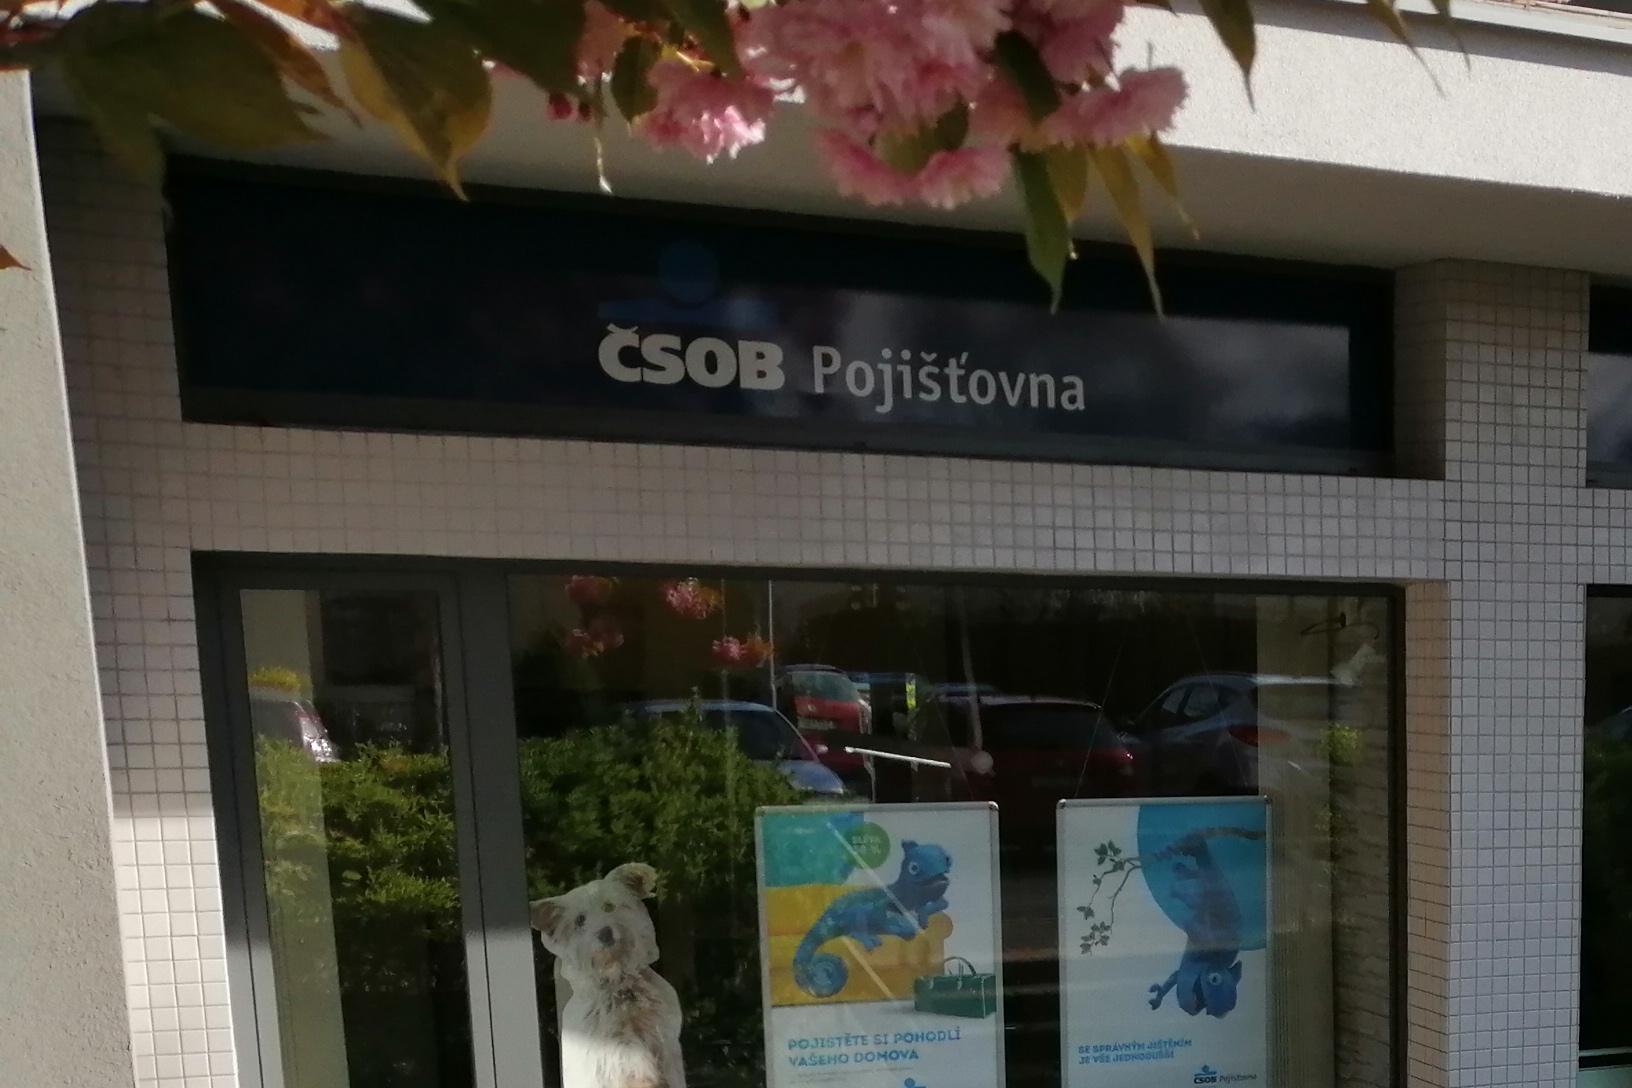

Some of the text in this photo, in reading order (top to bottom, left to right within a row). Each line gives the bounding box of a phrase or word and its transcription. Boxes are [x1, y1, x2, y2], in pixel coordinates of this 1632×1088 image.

[598, 323, 1086, 413] ČSOB Pojišťovna
[788, 1026, 961, 1050] POJISTĚTE SI POHODLÍ
[788, 1049, 919, 1067] VAŠEHO DOMOVA
